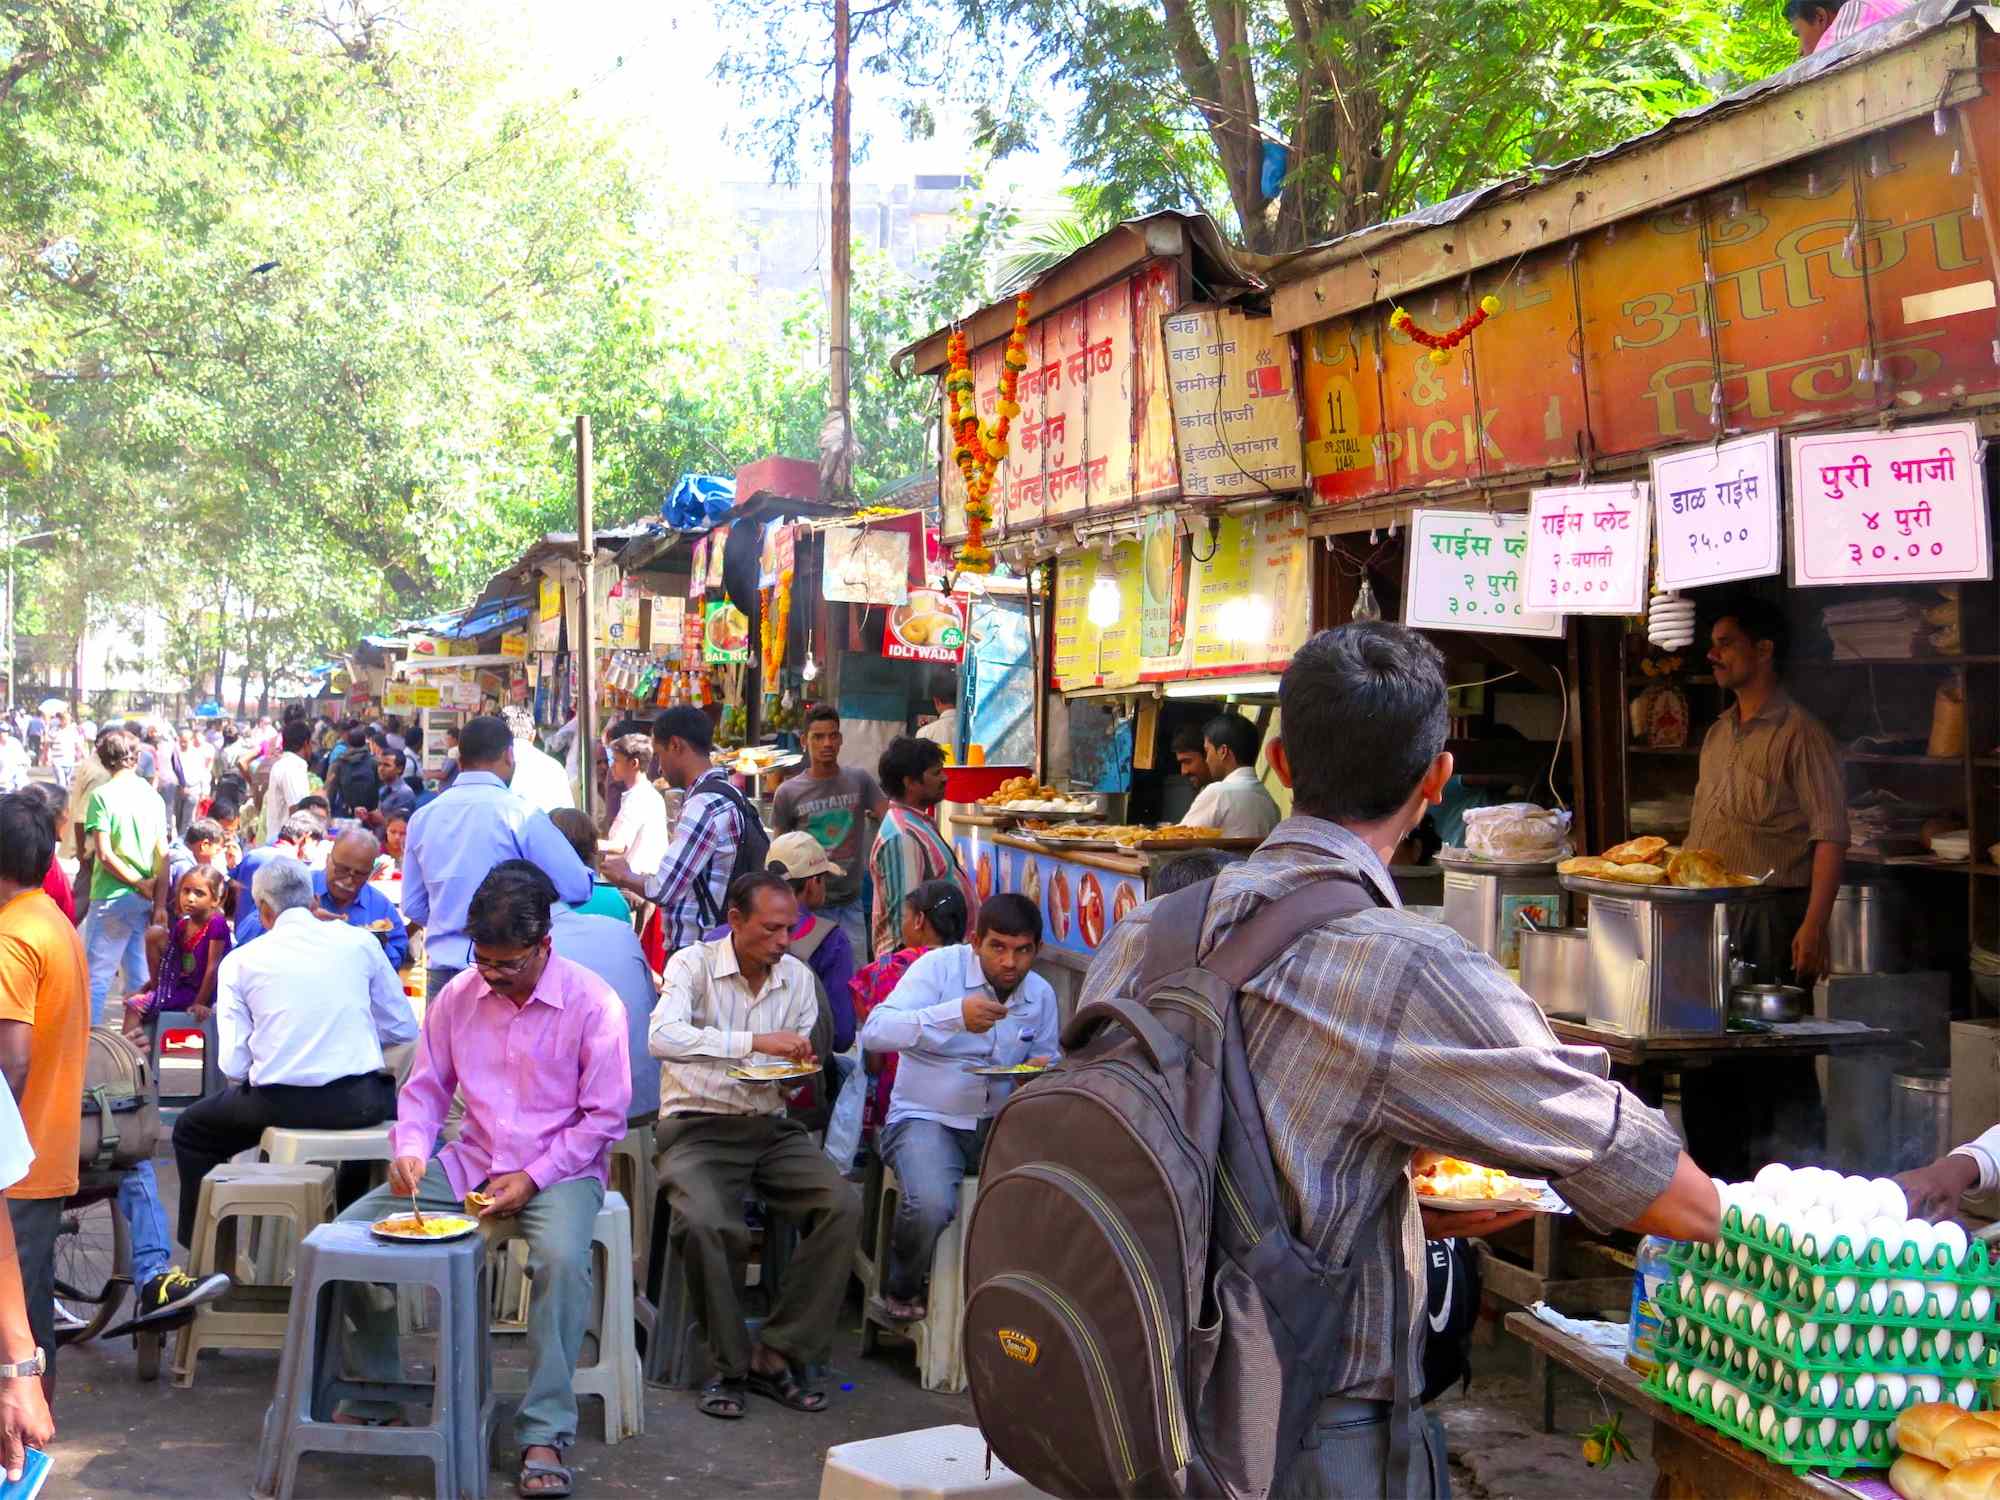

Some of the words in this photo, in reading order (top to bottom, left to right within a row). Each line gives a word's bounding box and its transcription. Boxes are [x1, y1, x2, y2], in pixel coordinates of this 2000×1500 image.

[1411, 353, 1448, 407] &
[1327, 389, 1346, 434] 11
[1372, 408, 1505, 481] PICK
[1670, 486, 1706, 514] डाळ
[1714, 469, 1759, 509] राईस
[1819, 455, 1871, 499] पुरी
[1890, 448, 1954, 484] भाजी
[1540, 505, 1584, 540] राईस
[1592, 503, 1632, 533] प्लेट
[1862, 512, 1879, 531] ४
[1894, 500, 1932, 536] पुरी
[1430, 528, 1492, 560] राईस
[1464, 573, 1474, 592] २
[1487, 570, 1519, 598] पुरी
[705, 651, 728, 661] DAL
[731, 650, 748, 660] RIC
[888, 644, 917, 656] IDLI
[919, 648, 958, 661] WADA
